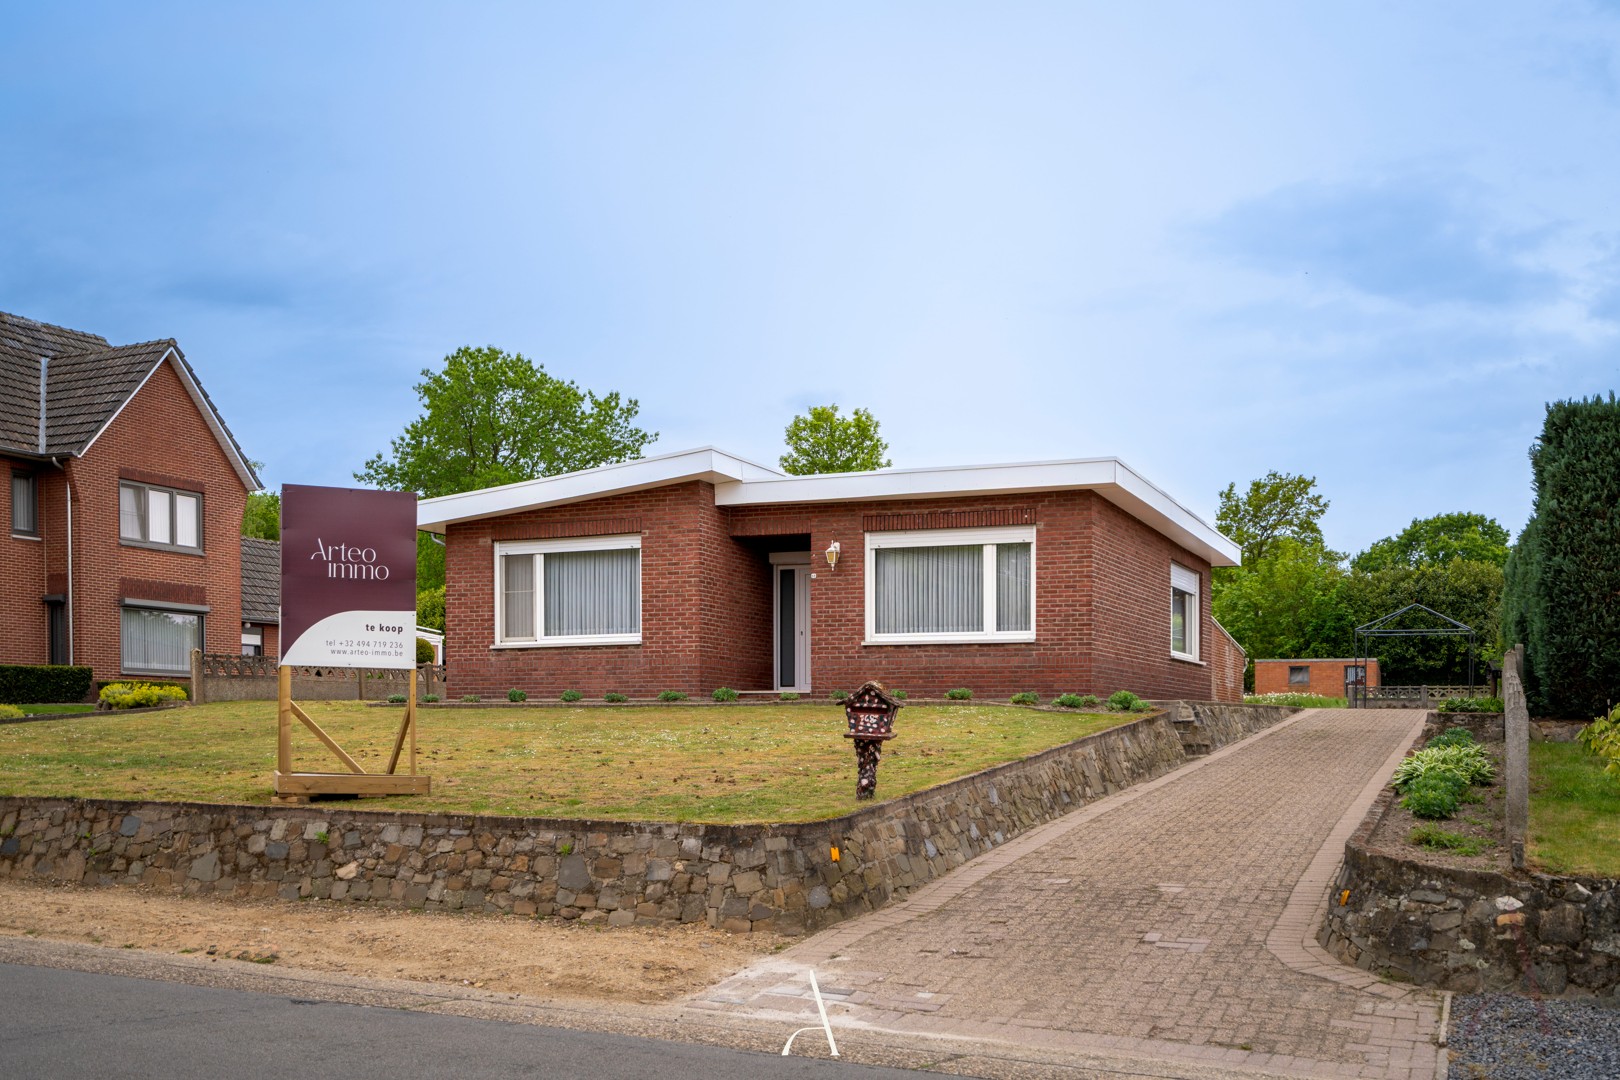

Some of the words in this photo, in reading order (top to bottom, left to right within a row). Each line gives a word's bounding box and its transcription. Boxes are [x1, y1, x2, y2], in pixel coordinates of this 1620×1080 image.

[310, 538, 377, 563] Arteo
[328, 562, 390, 580] immo
[365, 624, 375, 632] te
[379, 623, 404, 634] koop
[389, 641, 404, 649] 236
[330, 648, 404, 657] www.arteo-immo.be
